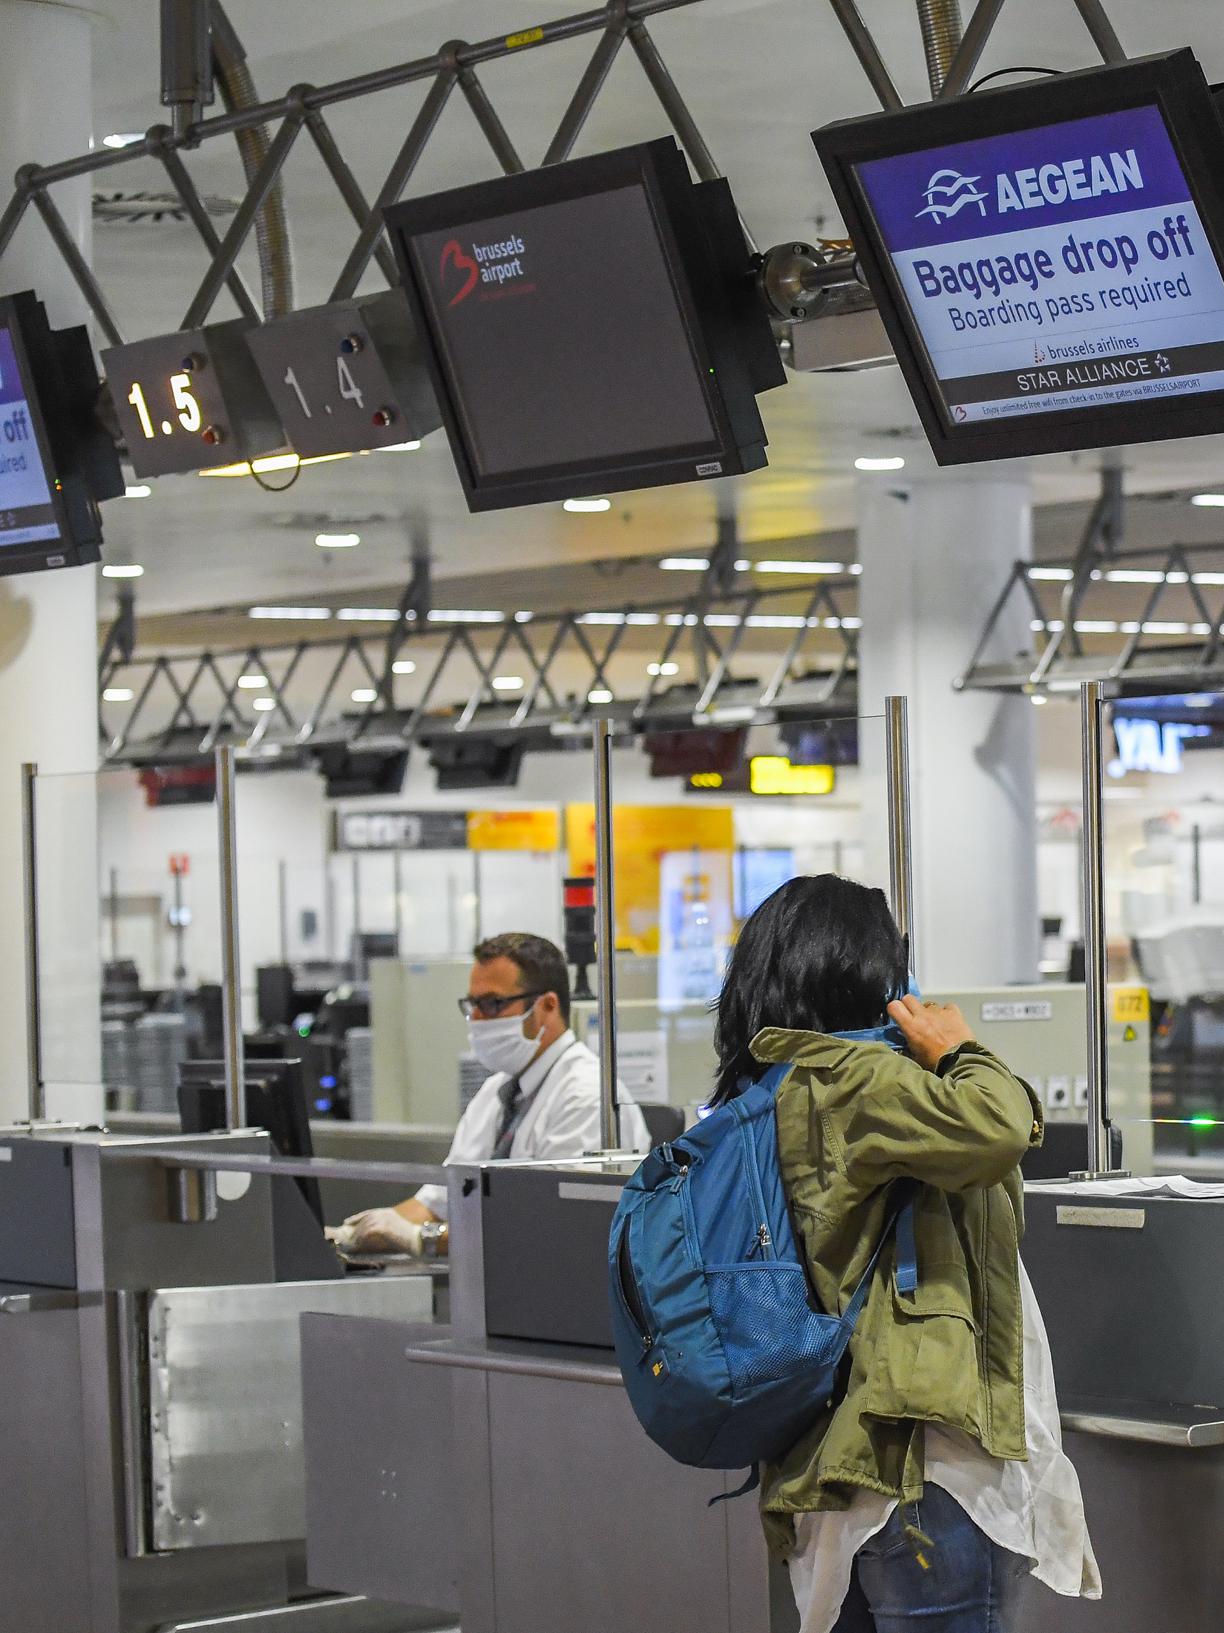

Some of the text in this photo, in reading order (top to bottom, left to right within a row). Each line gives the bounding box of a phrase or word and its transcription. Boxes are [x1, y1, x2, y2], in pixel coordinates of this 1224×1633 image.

[997, 149, 1144, 213] AEGEAN
[472, 234, 526, 262] brussels
[912, 214, 1195, 300] Baggage drop off
[480, 257, 524, 284] airport
[948, 271, 1192, 332] Boarding pass required
[1047, 335, 1140, 360] brussels airlines
[1016, 358, 1152, 392] STAR ALLIANCE
[1104, 390, 1115, 399] the
[3, 409, 29, 443] off
